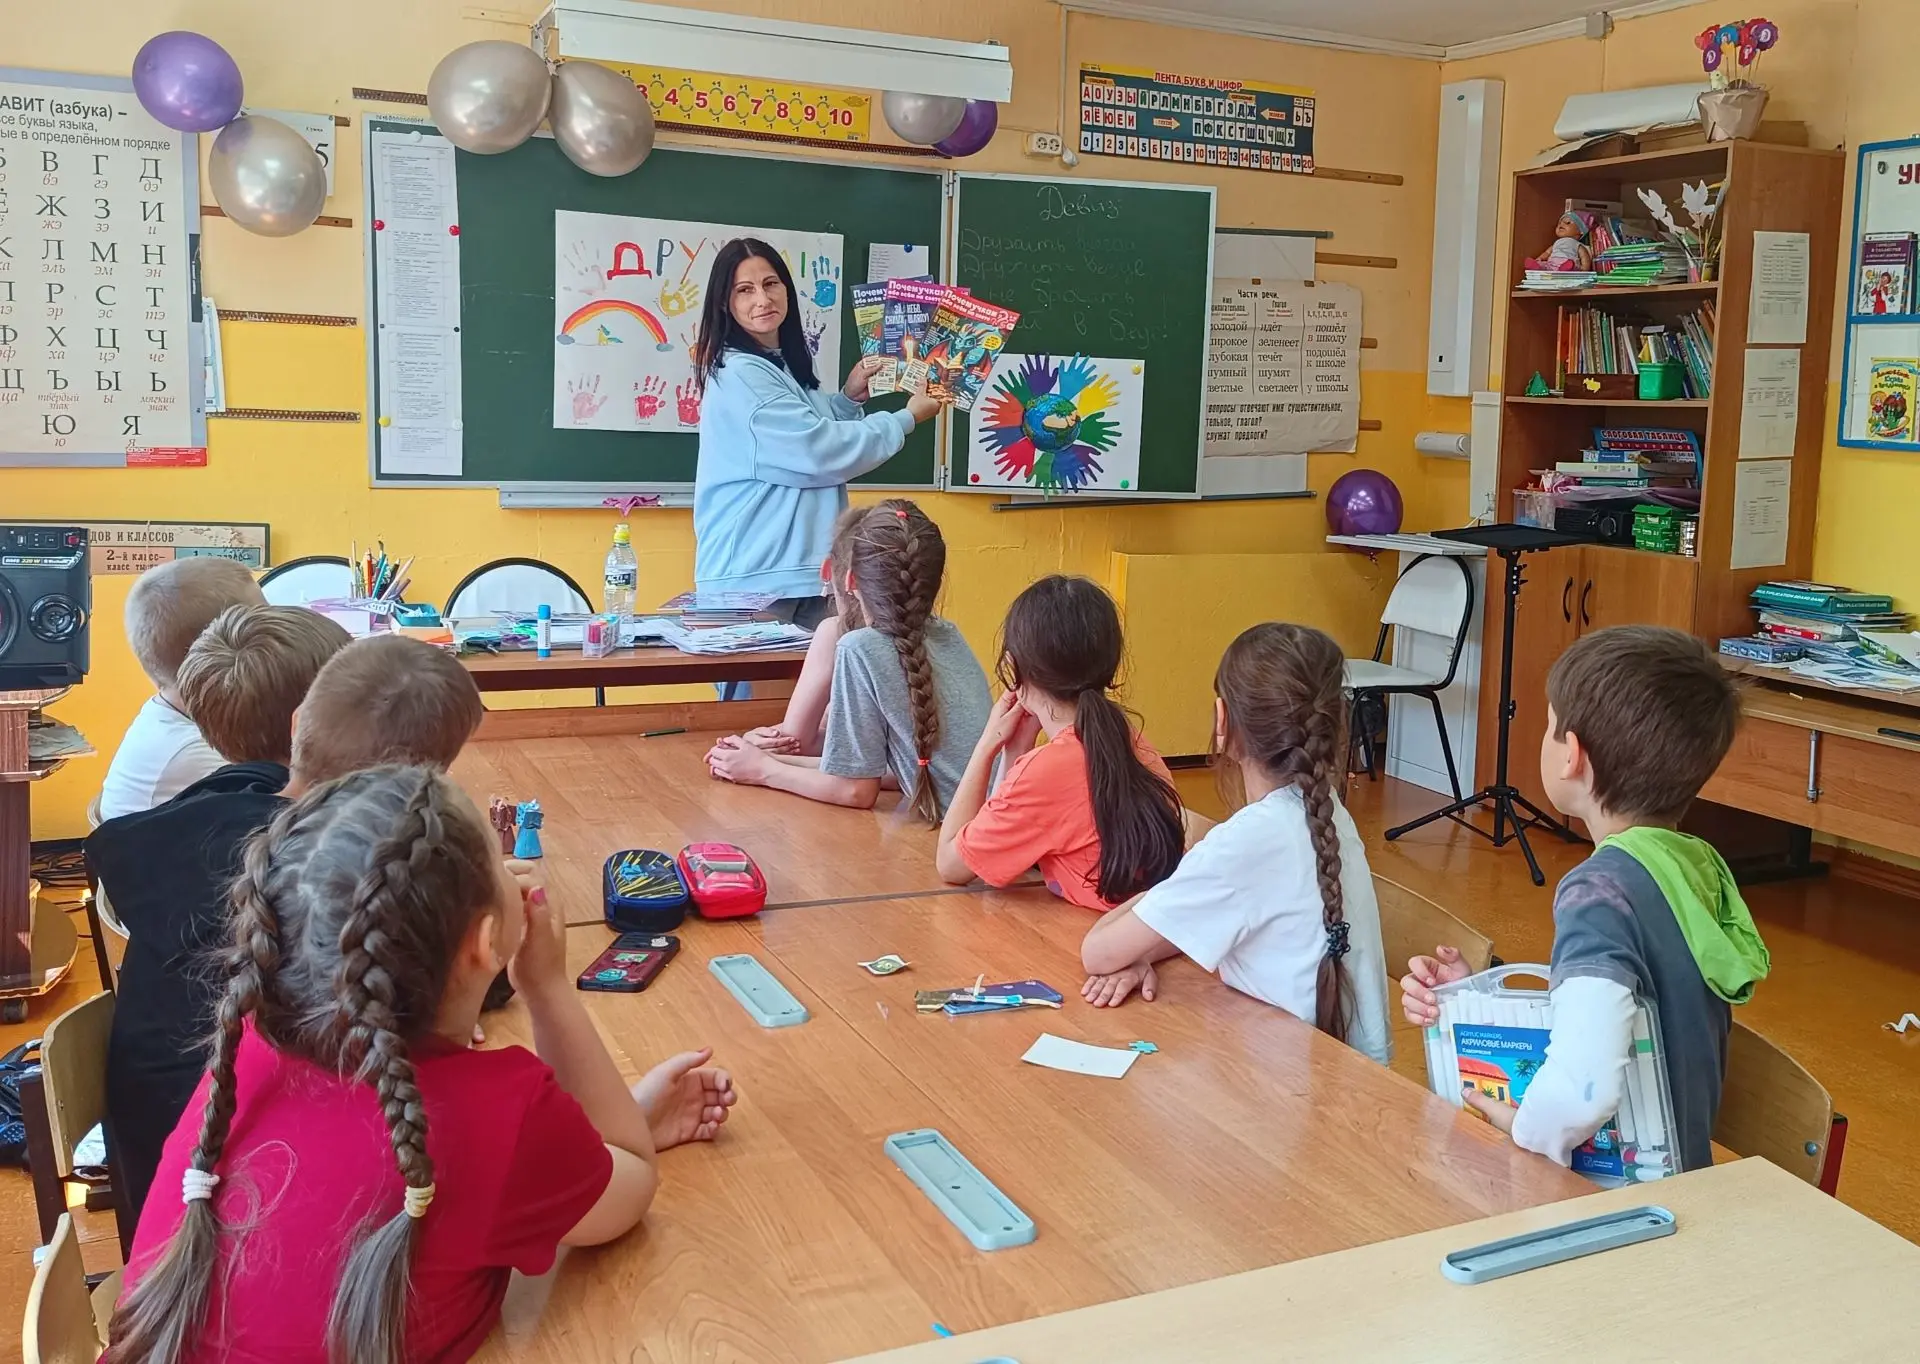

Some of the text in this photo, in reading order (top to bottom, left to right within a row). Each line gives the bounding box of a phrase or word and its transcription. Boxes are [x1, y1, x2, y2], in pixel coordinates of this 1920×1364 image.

[1154, 72, 1243, 91] ЛЕНТА БУКВ И ЦИФР
[1083, 86, 1091, 99] А
[1095, 87, 1101, 100] О
[1106, 88, 1114, 101] У
[1151, 94, 1158, 107] Р
[1161, 95, 1169, 109] Л
[1194, 98, 1202, 112] Б
[1205, 99, 1213, 112] В
[1217, 101, 1223, 114] Г
[50, 99, 112, 121] (азбука)
[664, 88, 679, 105] 4
[695, 91, 708, 108] 5
[723, 95, 736, 112] 6
[750, 98, 763, 115] 7
[776, 102, 789, 119] 8
[803, 105, 816, 121] 9
[829, 108, 853, 126] 10
[0, 114, 98, 132] се буквы языка,
[1084, 108, 1123, 126] Я Ё Ю Е
[1216, 124, 1223, 137] К
[1238, 126, 1245, 139] Т
[21, 131, 28, 139] в
[31, 131, 120, 146] определённом
[123, 138, 171, 151] порядке
[315, 143, 329, 168] 5
[1083, 136, 1312, 169] 0 1 3 5 7 9 11 12 15 20
[40, 151, 162, 184] В Г Д
[35, 194, 165, 222] Ж З И
[42, 219, 62, 230] жэ
[41, 238, 65, 261] Л
[89, 241, 119, 263] М
[141, 243, 166, 265] Н
[42, 263, 162, 278] эль эм эн
[45, 282, 64, 303] Р
[94, 284, 116, 305] С
[145, 286, 164, 307] Т
[1237, 288, 1279, 299] Части речи.
[47, 307, 113, 320] эр эс
[1260, 321, 1282, 332] идёт
[1315, 322, 1346, 333] пошёл
[46, 326, 67, 347] Х
[94, 327, 120, 353] Ц
[144, 329, 168, 351] Ч
[1258, 338, 1299, 347] зеленеет
[1307, 333, 1347, 345] в школу
[48, 350, 65, 360] ха
[1257, 352, 1283, 362] течёт
[1306, 347, 1346, 358] подошёл
[1315, 360, 1346, 368] школе
[47, 369, 69, 390] Ъ
[95, 370, 122, 391] Ы
[149, 371, 167, 392] Ь
[1258, 369, 1291, 380] шумят
[1315, 374, 1341, 383] стоял
[1258, 384, 1299, 393] светлеет
[1316, 384, 1349, 393] школы
[1208, 403, 1343, 414] вопросы отвечают имя существительное,
[41, 414, 142, 436] Ю Я
[1236, 416, 1263, 427] глагол?
[1206, 429, 1268, 442] служат предлоги?
[1646, 431, 1688, 442] ТАБЛИЦА
[91, 531, 174, 543] ДОВ И КЛАССОВ
[106, 563, 130, 571] класс
[1461, 1037, 1533, 1051] АКРИЛОВЫЕ МАРКЕРЫ
[1594, 1131, 1609, 1143] 48
